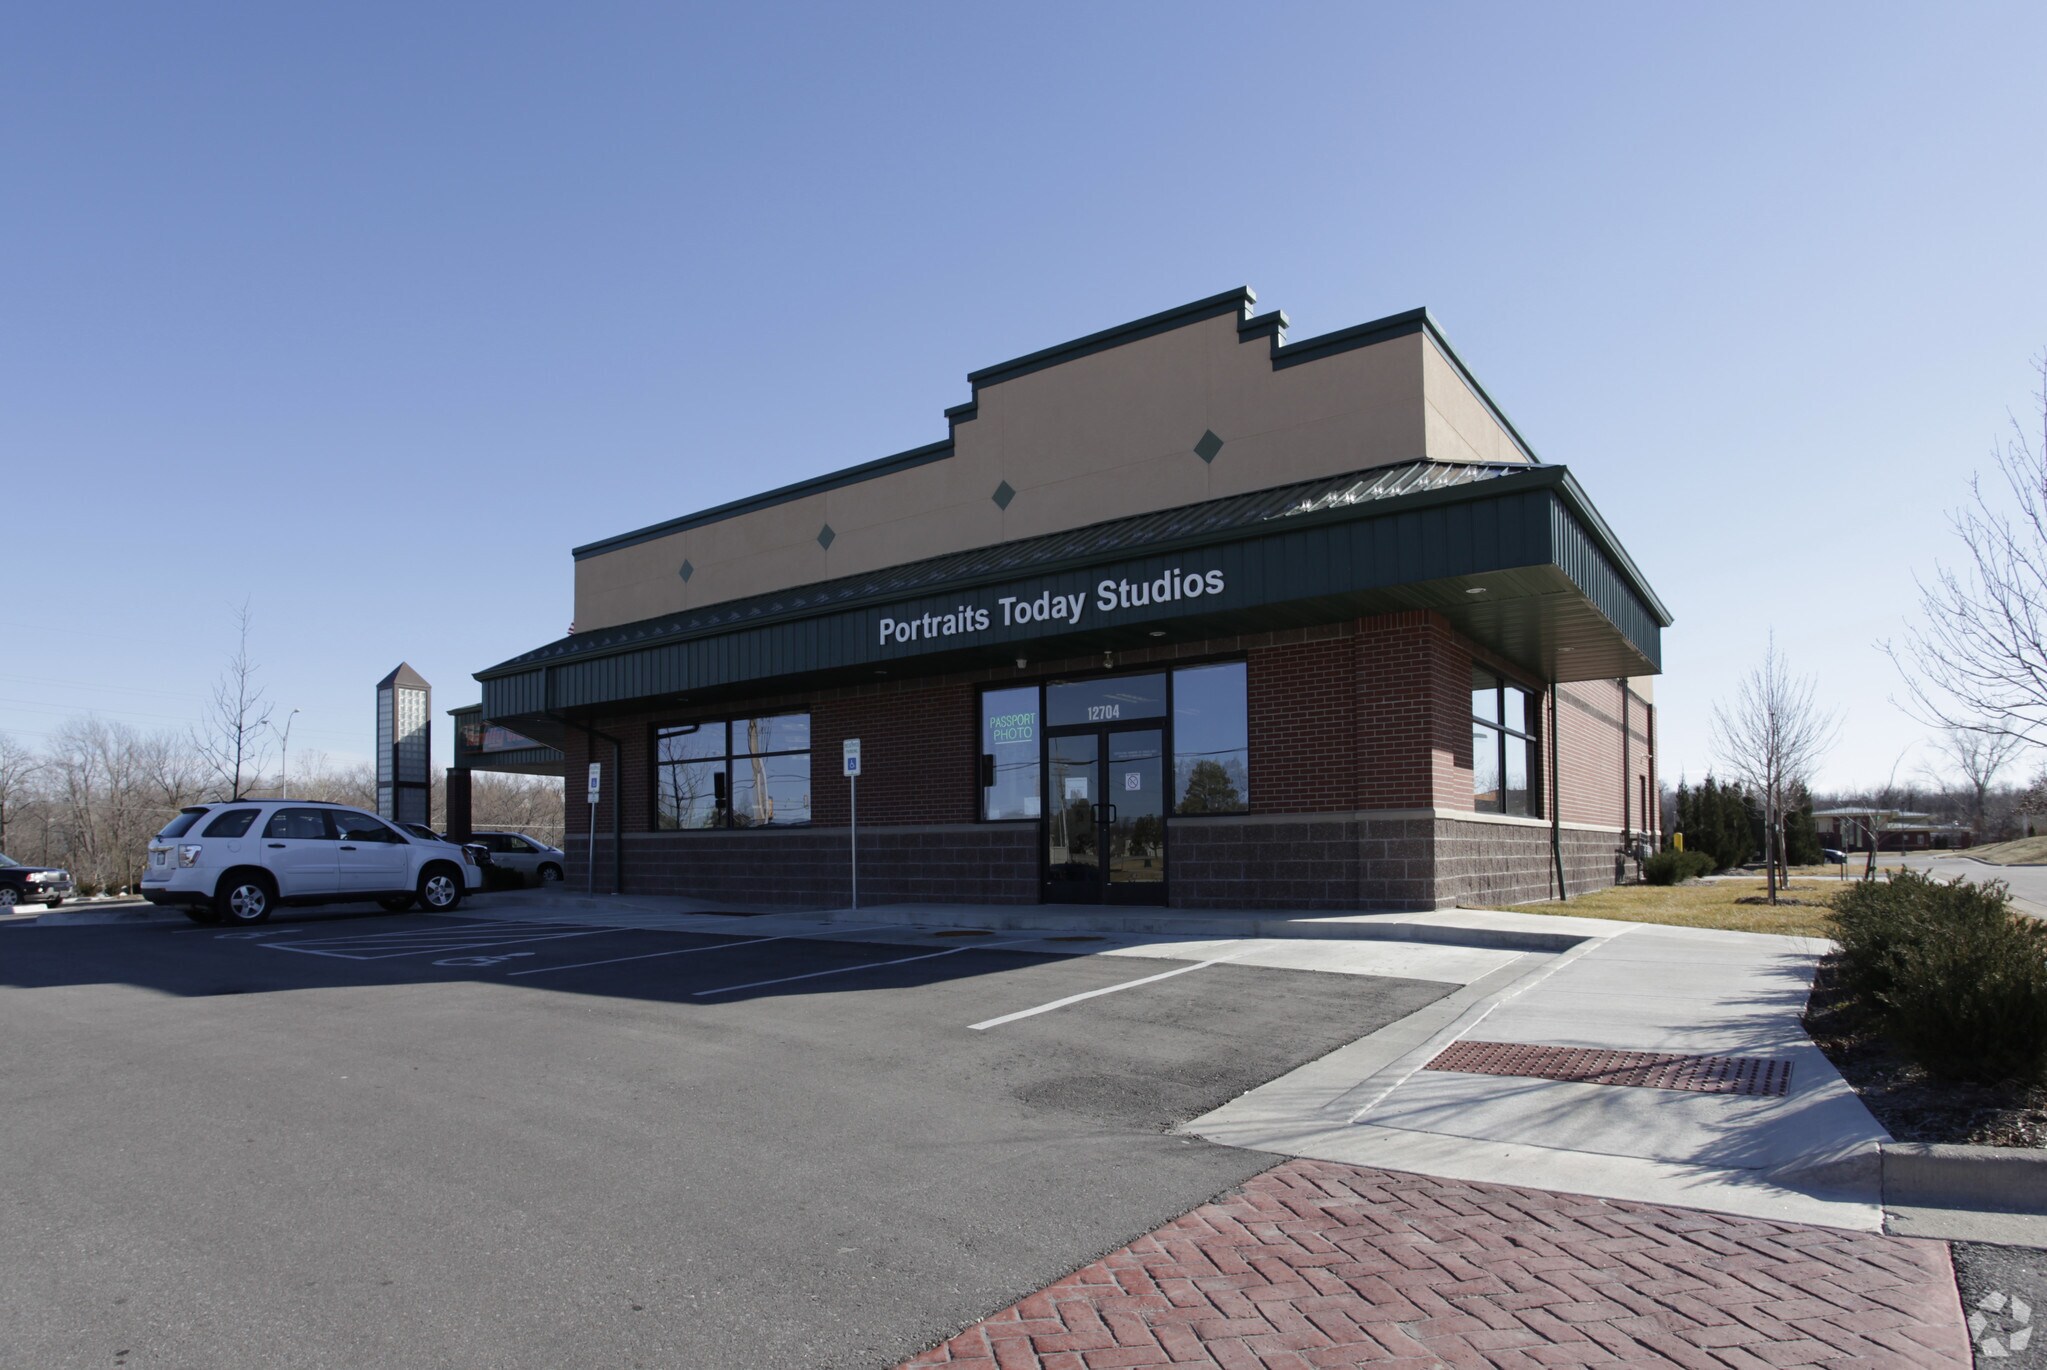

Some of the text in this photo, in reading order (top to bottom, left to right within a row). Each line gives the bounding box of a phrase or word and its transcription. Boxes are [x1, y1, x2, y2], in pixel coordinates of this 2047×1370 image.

[879, 568, 1225, 646] Portraits Today Studios
[989, 712, 1036, 728] PASSPORT
[1087, 704, 1120, 720] 12704
[993, 726, 1033, 741] PHOTO
